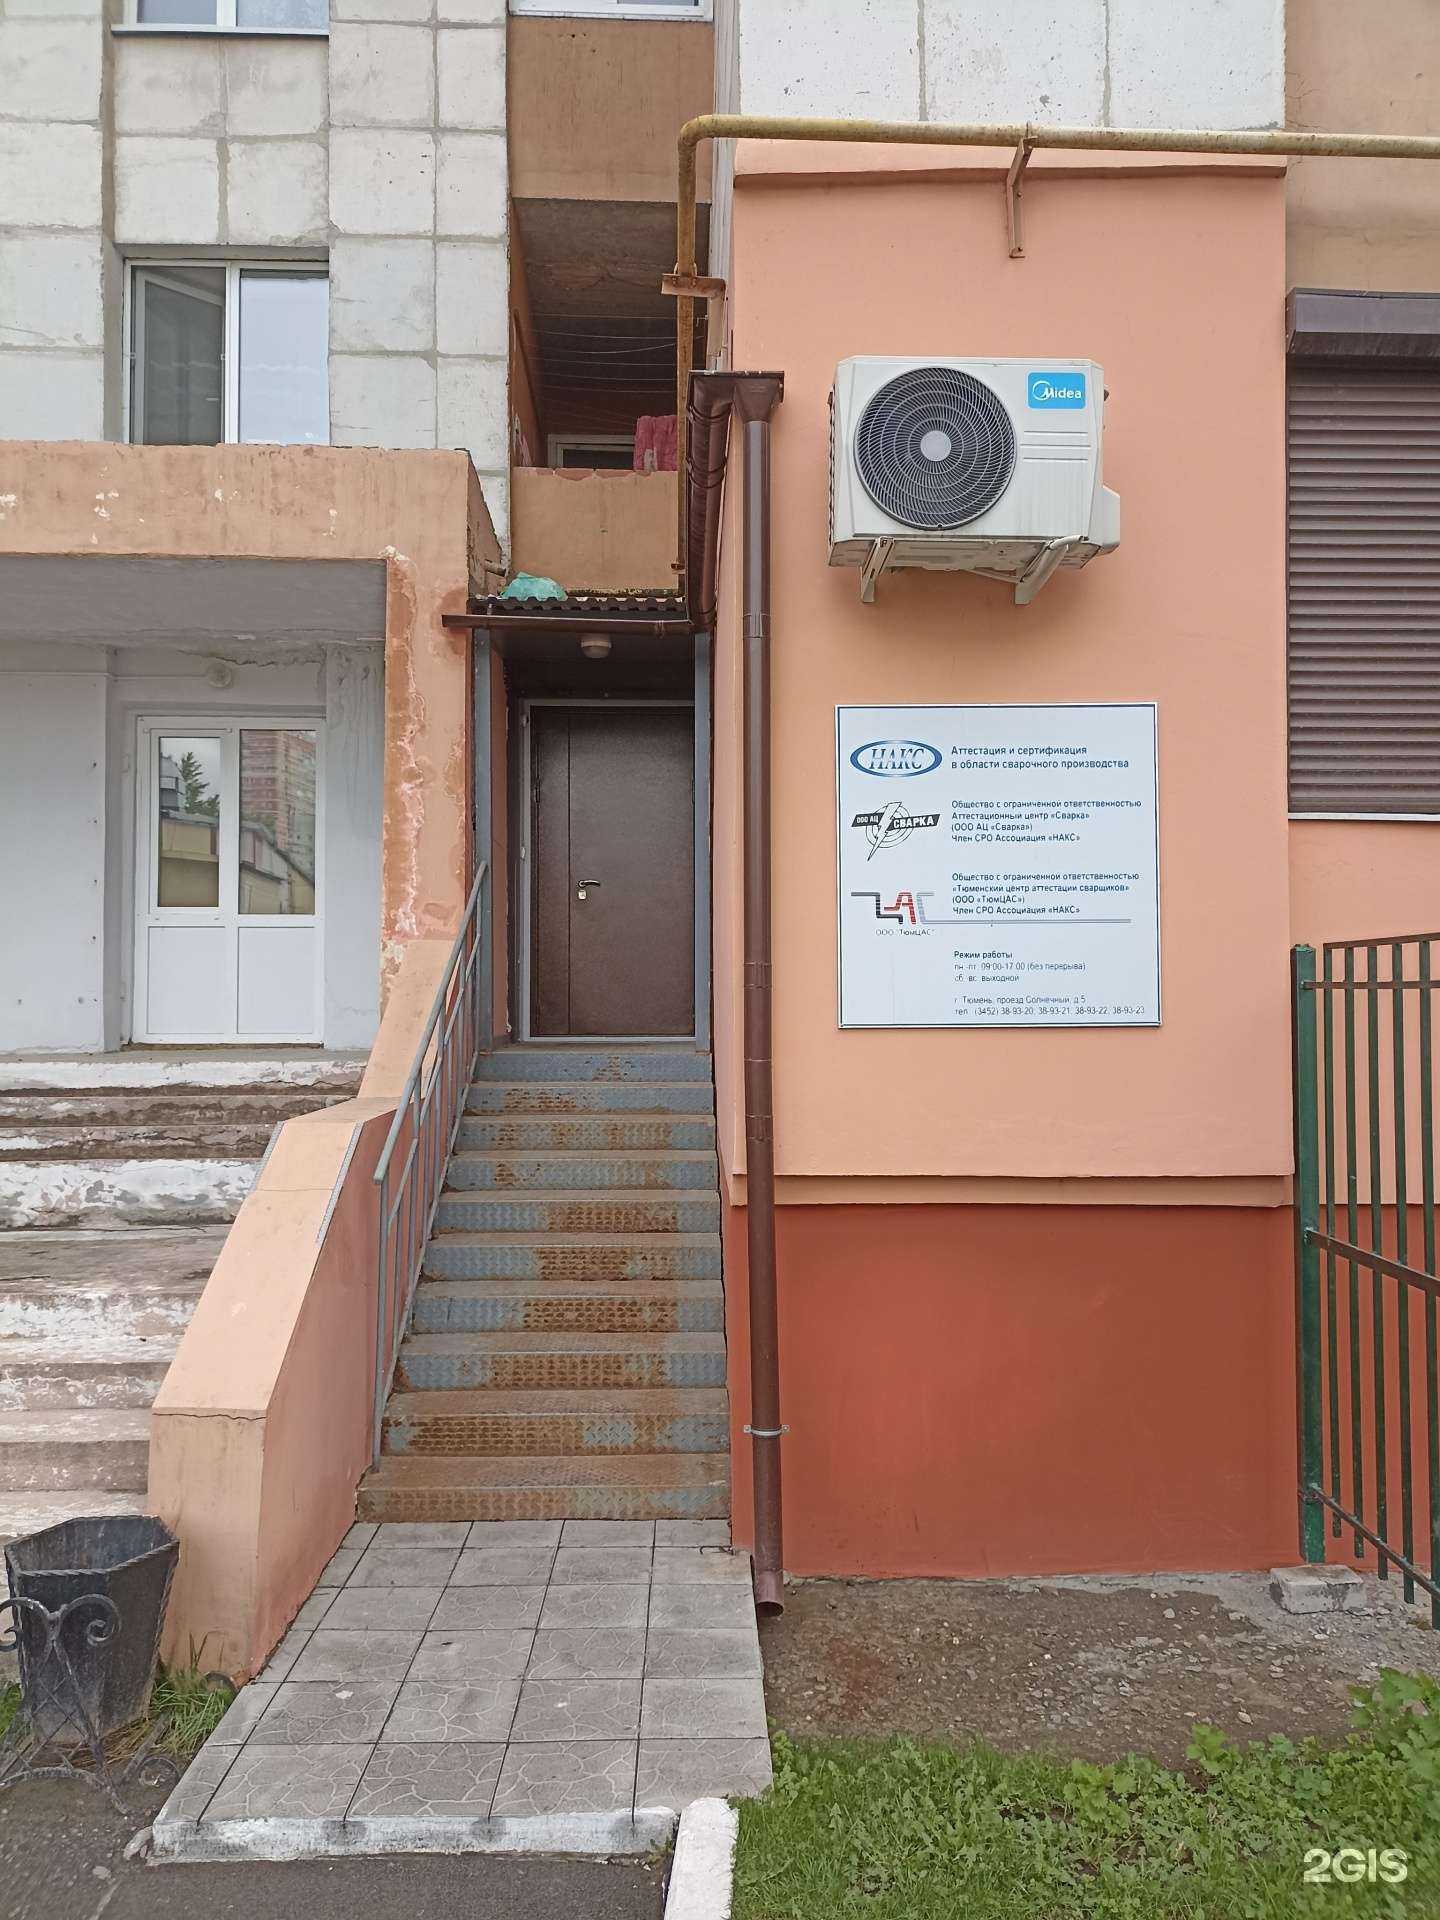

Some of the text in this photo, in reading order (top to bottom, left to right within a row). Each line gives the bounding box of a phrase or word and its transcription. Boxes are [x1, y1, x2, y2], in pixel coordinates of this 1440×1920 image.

[1038, 385, 1083, 400] Midea
[951, 745, 1087, 757] Аттестация и сертификация
[869, 748, 925, 770] НАКС
[960, 759, 999, 768] области
[1002, 760, 1058, 770] сварочного
[1061, 759, 1129, 770] производства
[951, 800, 994, 808] Общество
[1063, 800, 1142, 808] ответственностью
[856, 816, 869, 824] ООО
[1024, 812, 1049, 821] центр
[1050, 810, 1090, 821] «Сварка»
[893, 815, 935, 829] СВАРКА
[951, 822, 1033, 832] (ООО АЦ «Сварка»)
[951, 832, 1080, 842] Член СРО Ассоциация «НАКС»
[952, 872, 994, 881] Общество
[996, 873, 1001, 881] с
[1062, 872, 1140, 880] ответственностью
[1005, 885, 1030, 894] центр
[1031, 884, 1078, 893] аттестации
[1079, 884, 1130, 893] сварщиков»
[952, 894, 1025, 904] (ООО «ТюмЦАС»)
[952, 905, 1080, 915] Член СРО Ассоциация «НАКС»
[954, 950, 1013, 960] Режим работы
[1027, 961, 1044, 972] (без
[996, 996, 1024, 1005] проезд
[974, 1006, 999, 1016] (3452)
